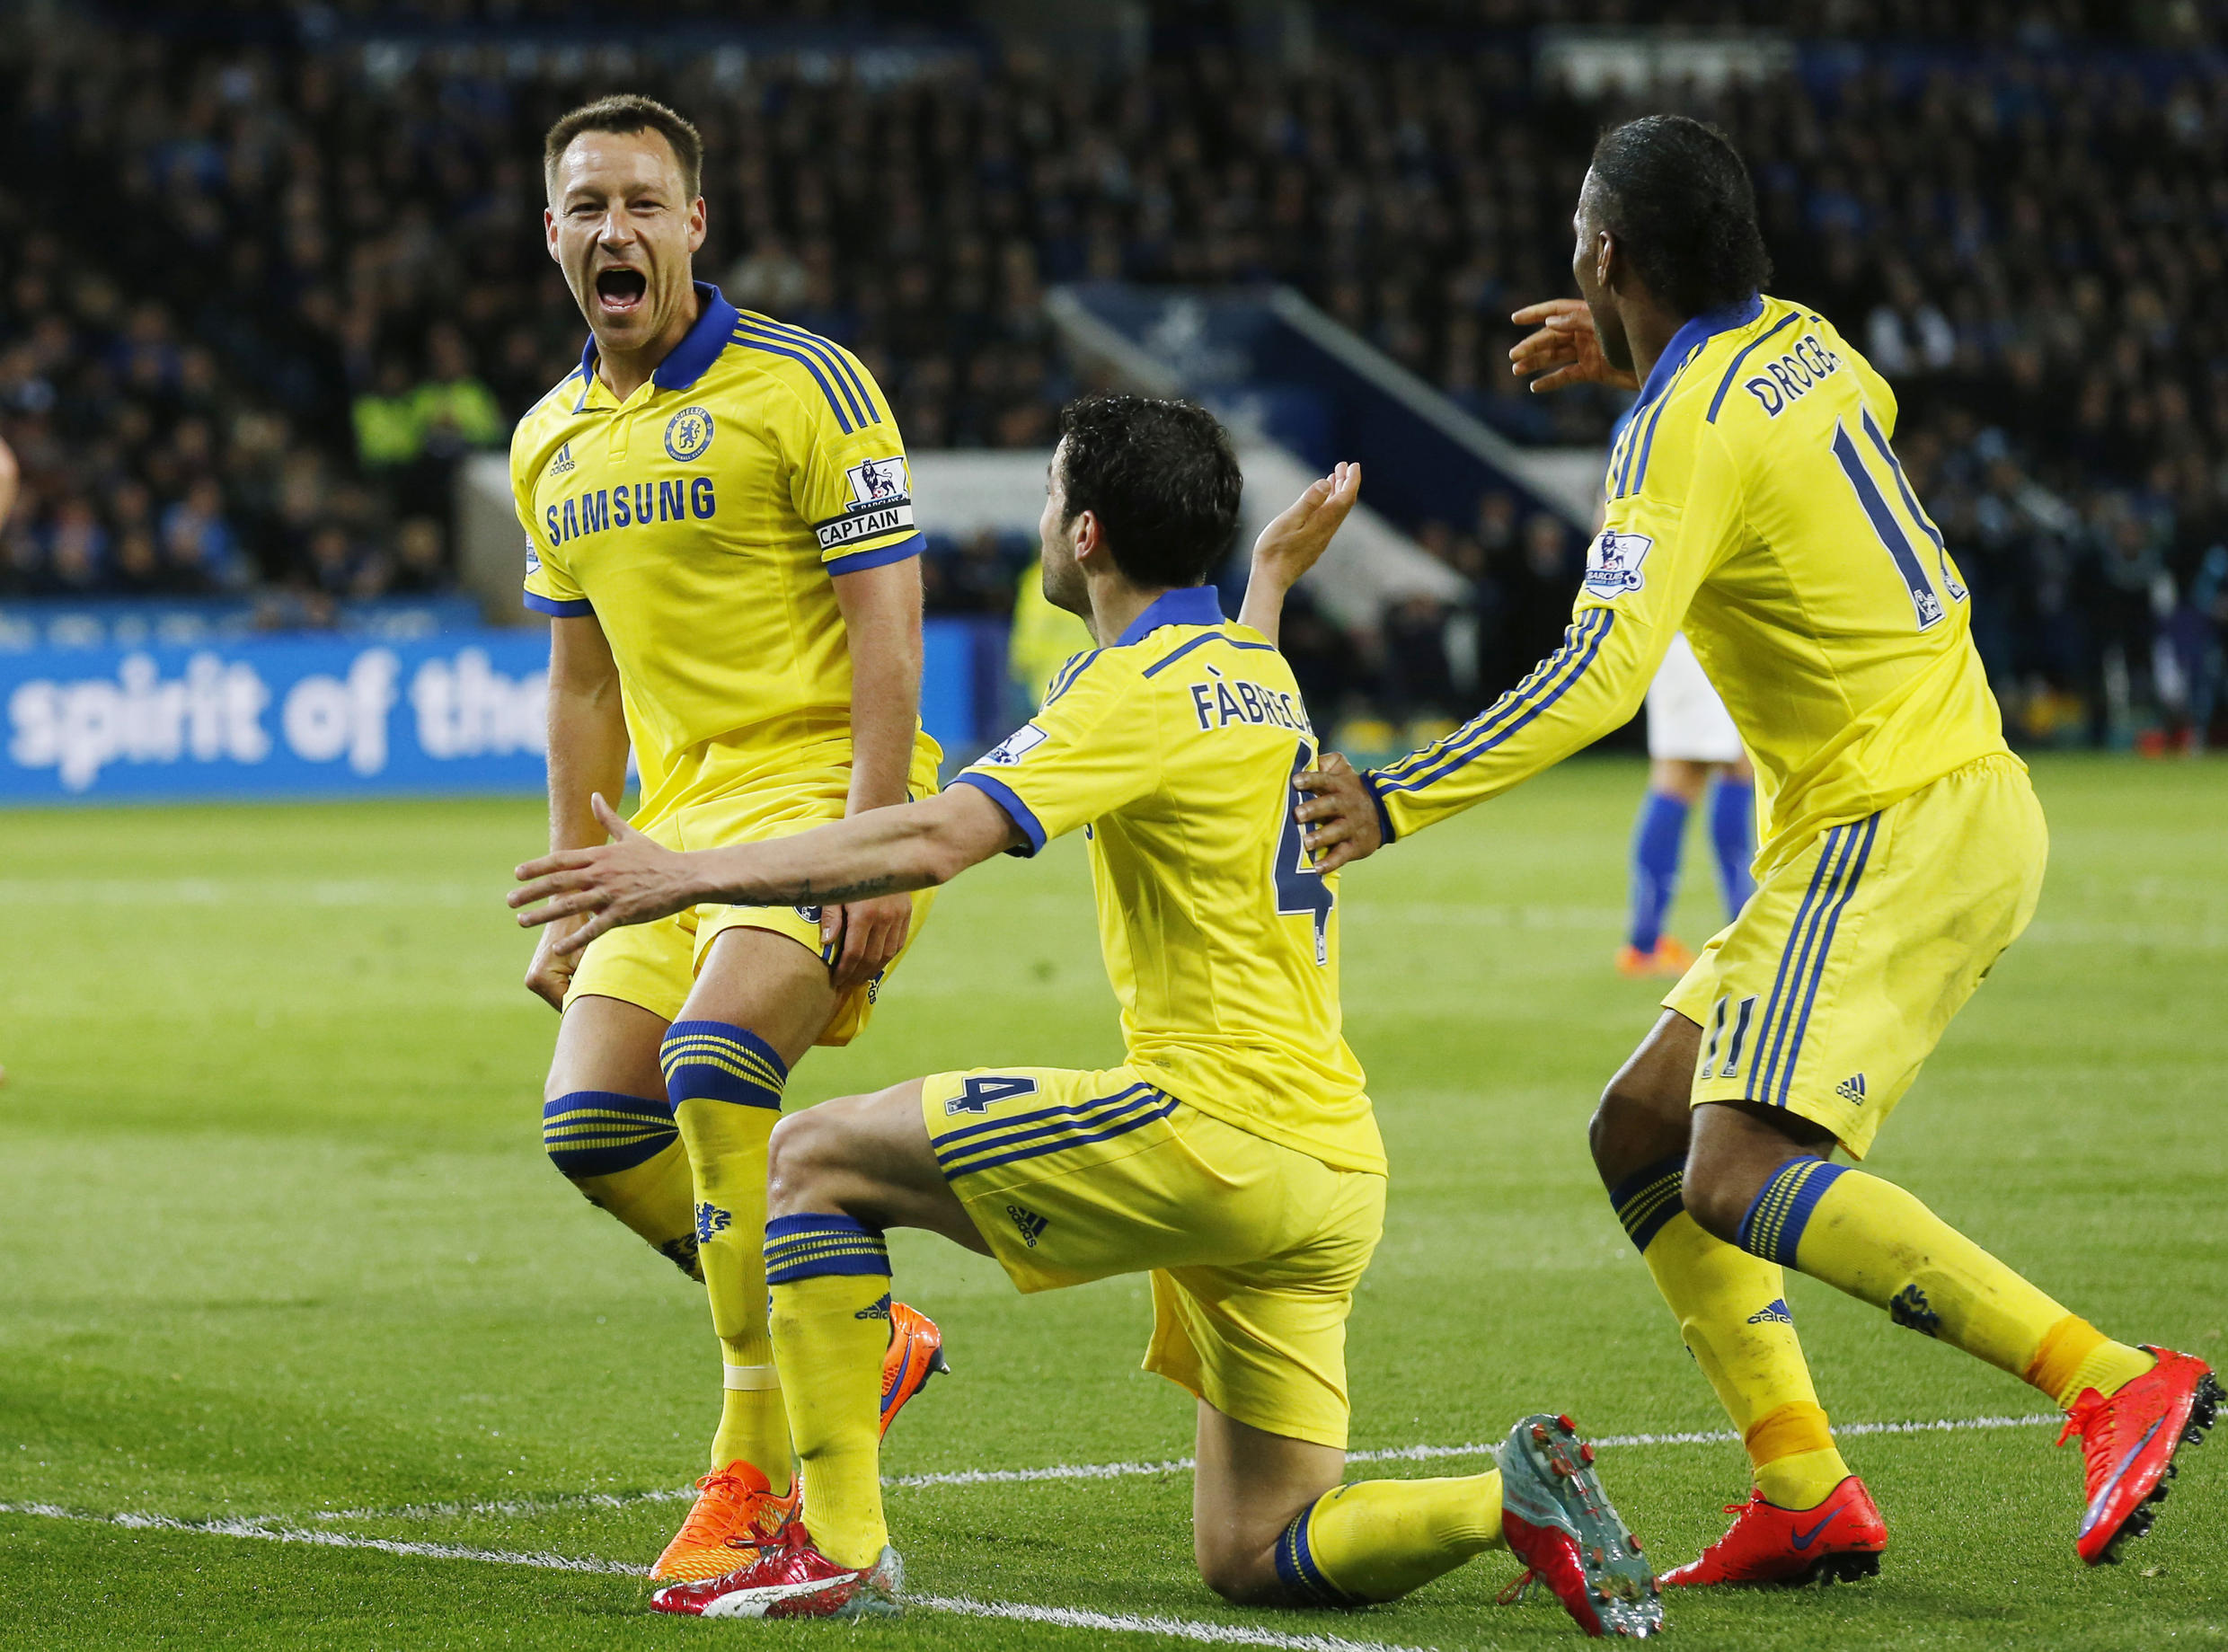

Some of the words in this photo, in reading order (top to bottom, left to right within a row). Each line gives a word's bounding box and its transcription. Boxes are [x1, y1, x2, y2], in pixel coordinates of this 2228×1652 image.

[675, 408, 707, 420] CHELSEA
[549, 460, 575, 477] adidas
[546, 477, 716, 547] SAMSUNG
[819, 509, 899, 545] CAPTAIN
[1829, 402, 1969, 632] 11
[9, 650, 270, 791] spirit
[283, 647, 399, 775] of
[1271, 738, 1333, 966] 4
[1701, 993, 1760, 1078] 11
[944, 1075, 1039, 1117] 4
[1006, 1205, 1037, 1248] adidas
